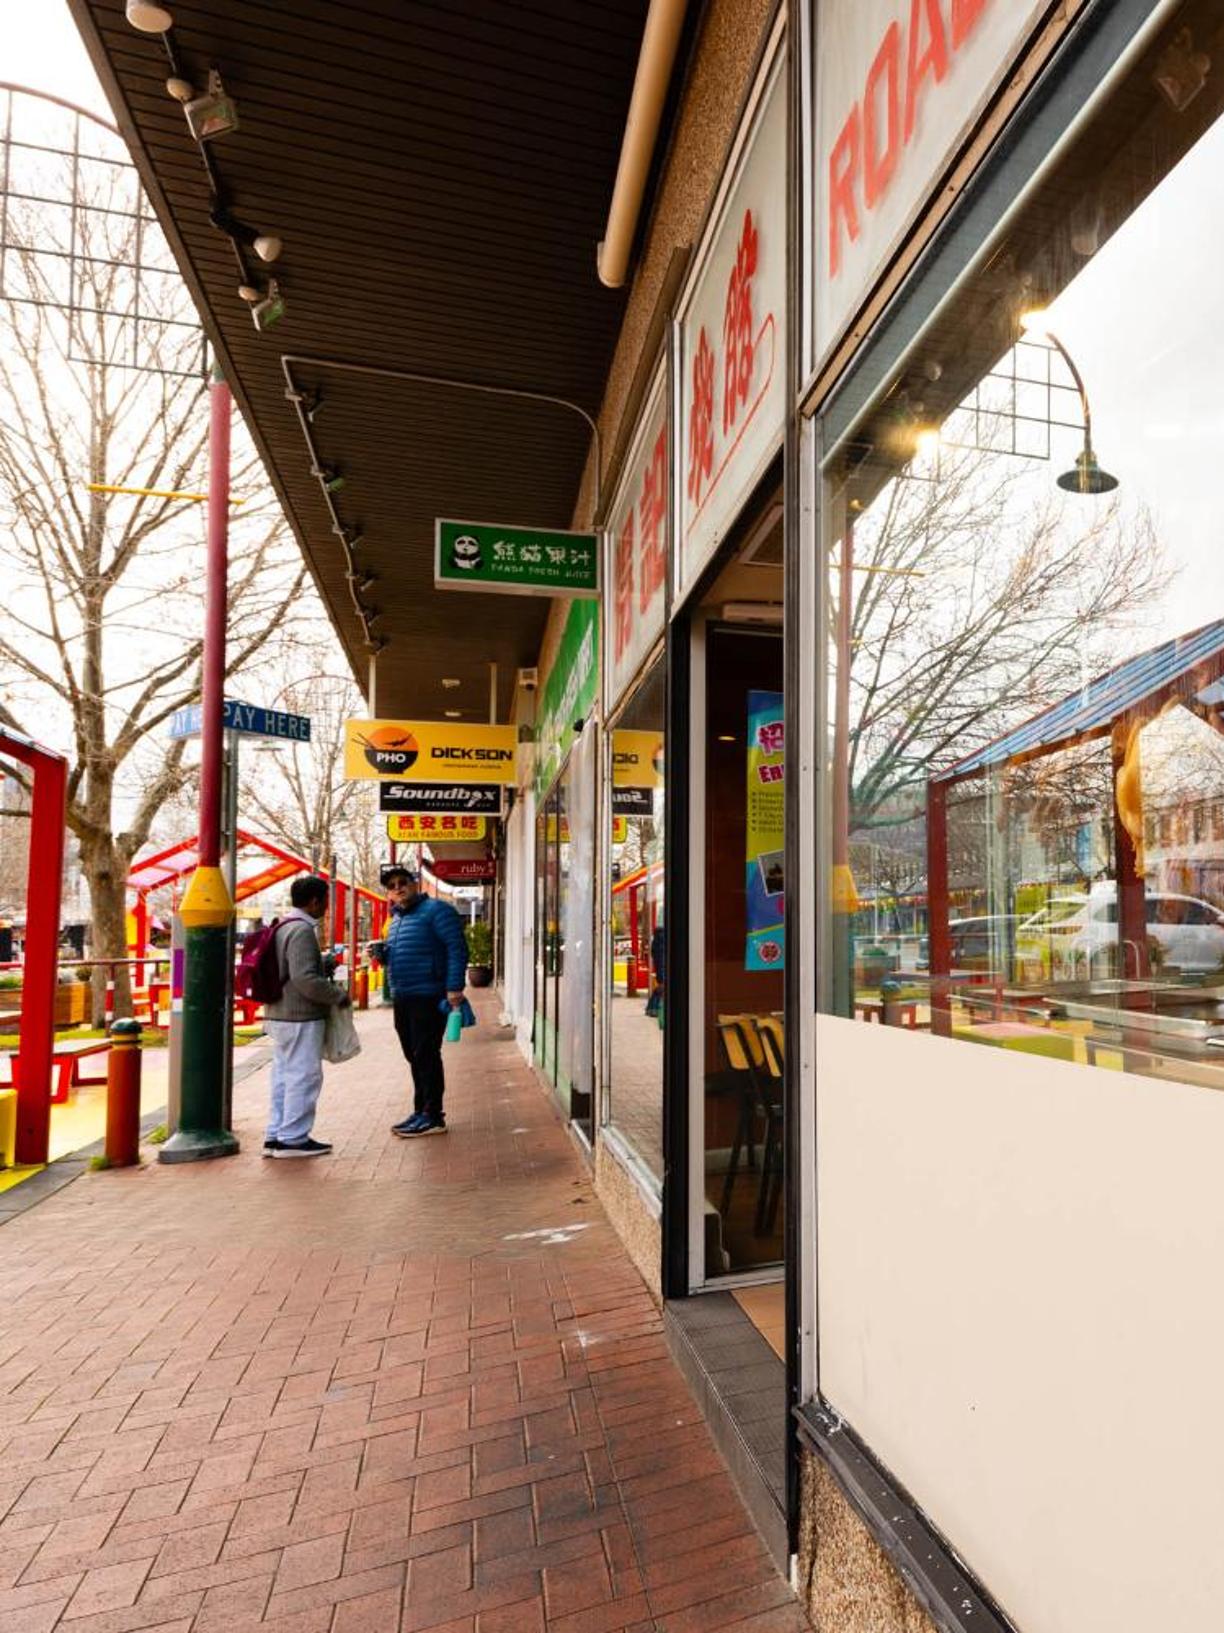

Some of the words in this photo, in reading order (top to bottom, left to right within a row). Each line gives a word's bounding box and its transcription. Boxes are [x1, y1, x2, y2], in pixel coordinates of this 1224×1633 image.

[223, 704, 256, 728] PAY
[265, 713, 308, 739] HERE
[376, 752, 406, 763] PHO
[431, 747, 513, 761] DICKSON
[383, 785, 496, 806] Soundbox
[398, 815, 478, 830] 西安名吃
[461, 863, 486, 874] ruby
